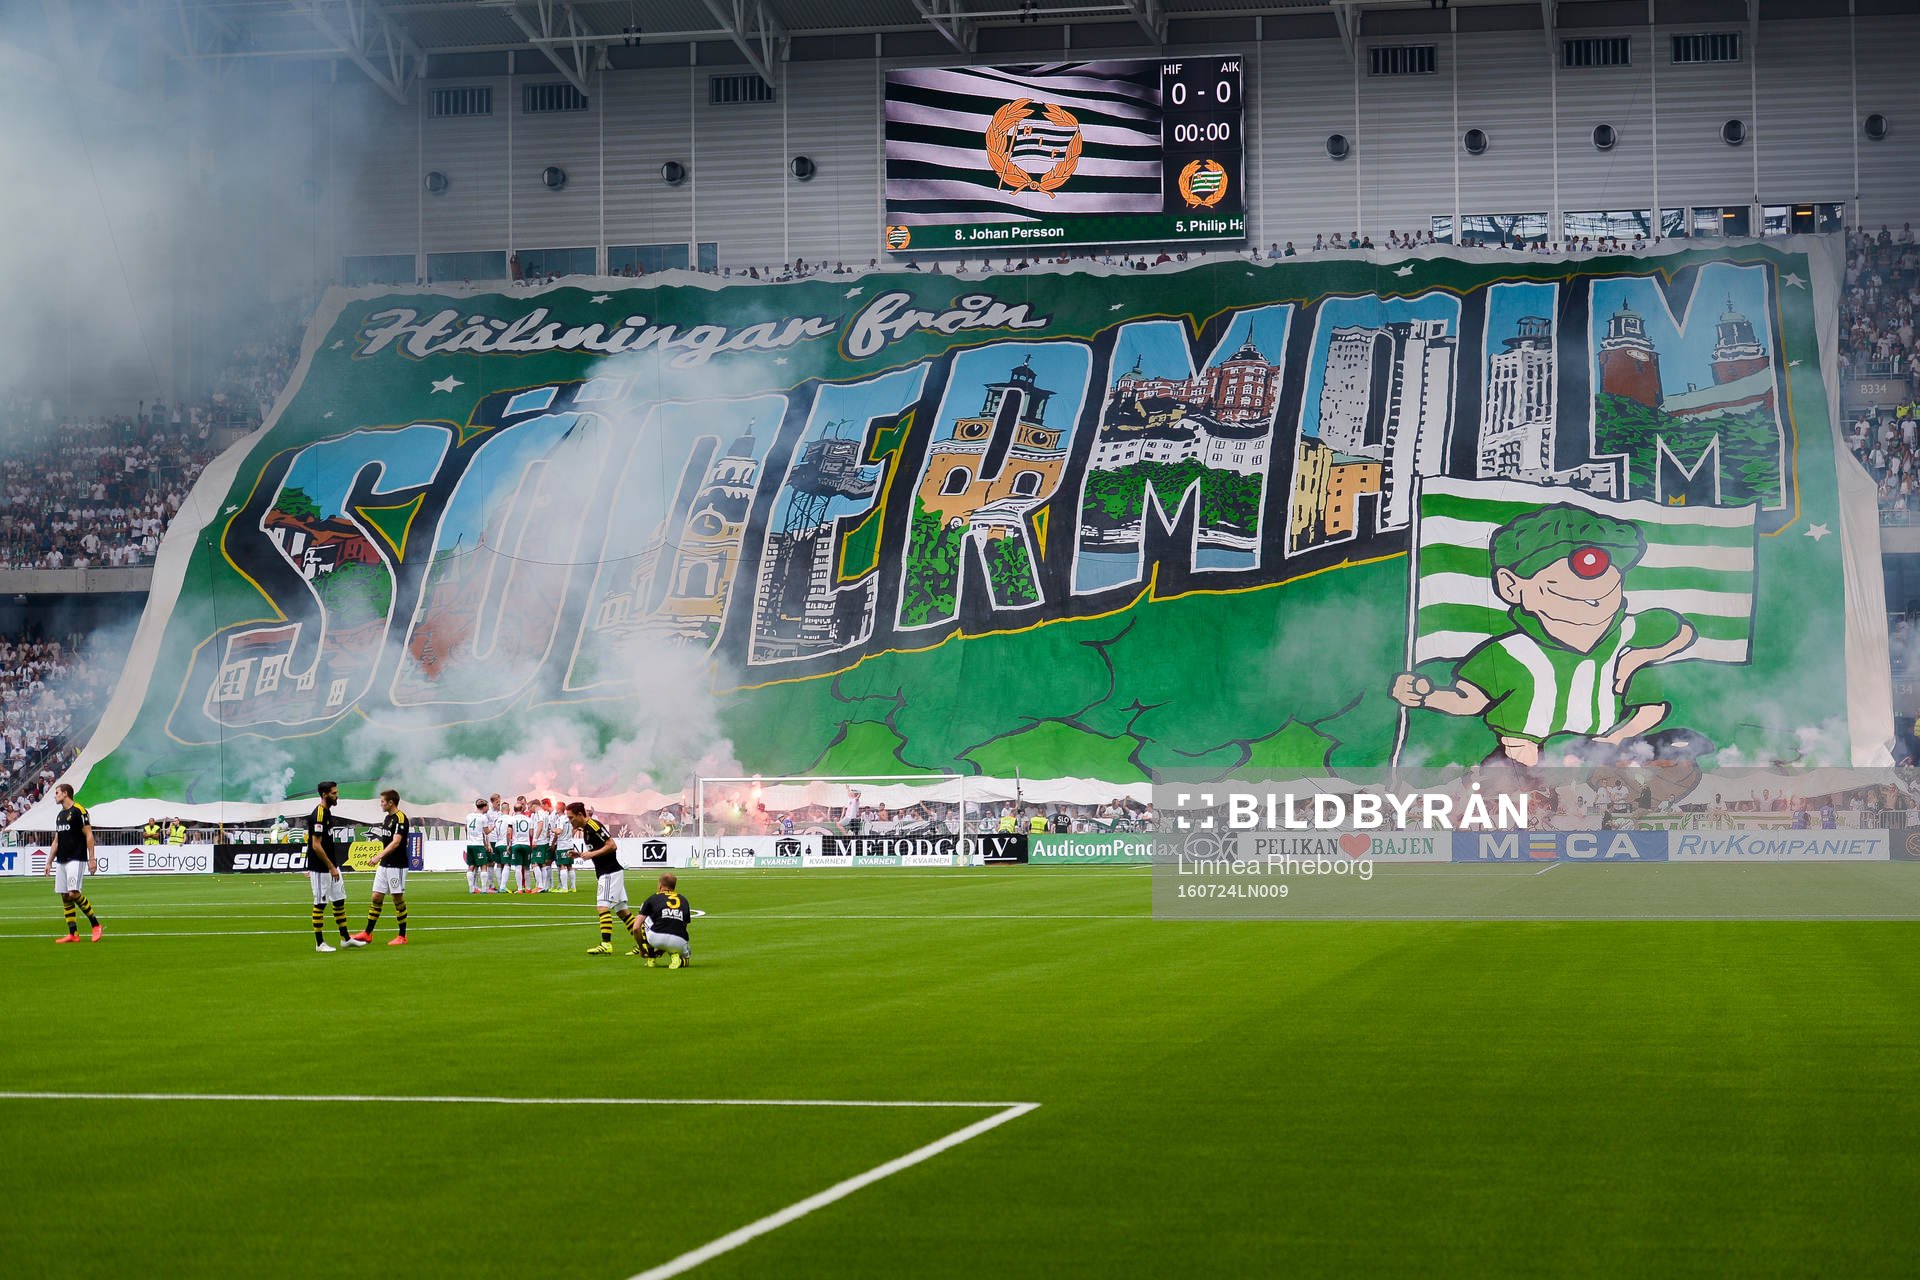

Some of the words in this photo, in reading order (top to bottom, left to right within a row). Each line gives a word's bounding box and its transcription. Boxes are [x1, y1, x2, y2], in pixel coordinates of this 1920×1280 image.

[1163, 64, 1183, 75] HIF
[1220, 62, 1240, 73] AIK
[1172, 82, 1187, 105] 0
[1216, 81, 1231, 103] 0
[1174, 122, 1230, 142] 00:00
[954, 229, 966, 240] 8.
[969, 228, 1009, 240] Johan
[1011, 226, 1064, 238] Persson
[1176, 220, 1187, 232] 5.
[1189, 218, 1227, 235] Philip
[365, 308, 840, 369] Hälsningar
[848, 295, 1046, 358] från
[469, 818, 477, 831] 4
[516, 819, 529, 833] 10
[1057, 815, 1070, 824] SLO
[1032, 839, 1179, 857] AudicomPendax
[1254, 838, 1339, 855] PELIKAN
[1371, 837, 1435, 855] BAJEN
[1479, 833, 1641, 859] MECA
[147, 853, 207, 871] Botrygg
[232, 846, 308, 870] swed
[707, 858, 744, 866] KVARNEN
[760, 857, 798, 866] KVARNEN
[808, 858, 847, 866] KVARNEN
[858, 857, 896, 865] KVARNEN
[912, 856, 950, 864] KVARNEN
[666, 891, 681, 909] 3
[661, 908, 683, 918] SVEA
